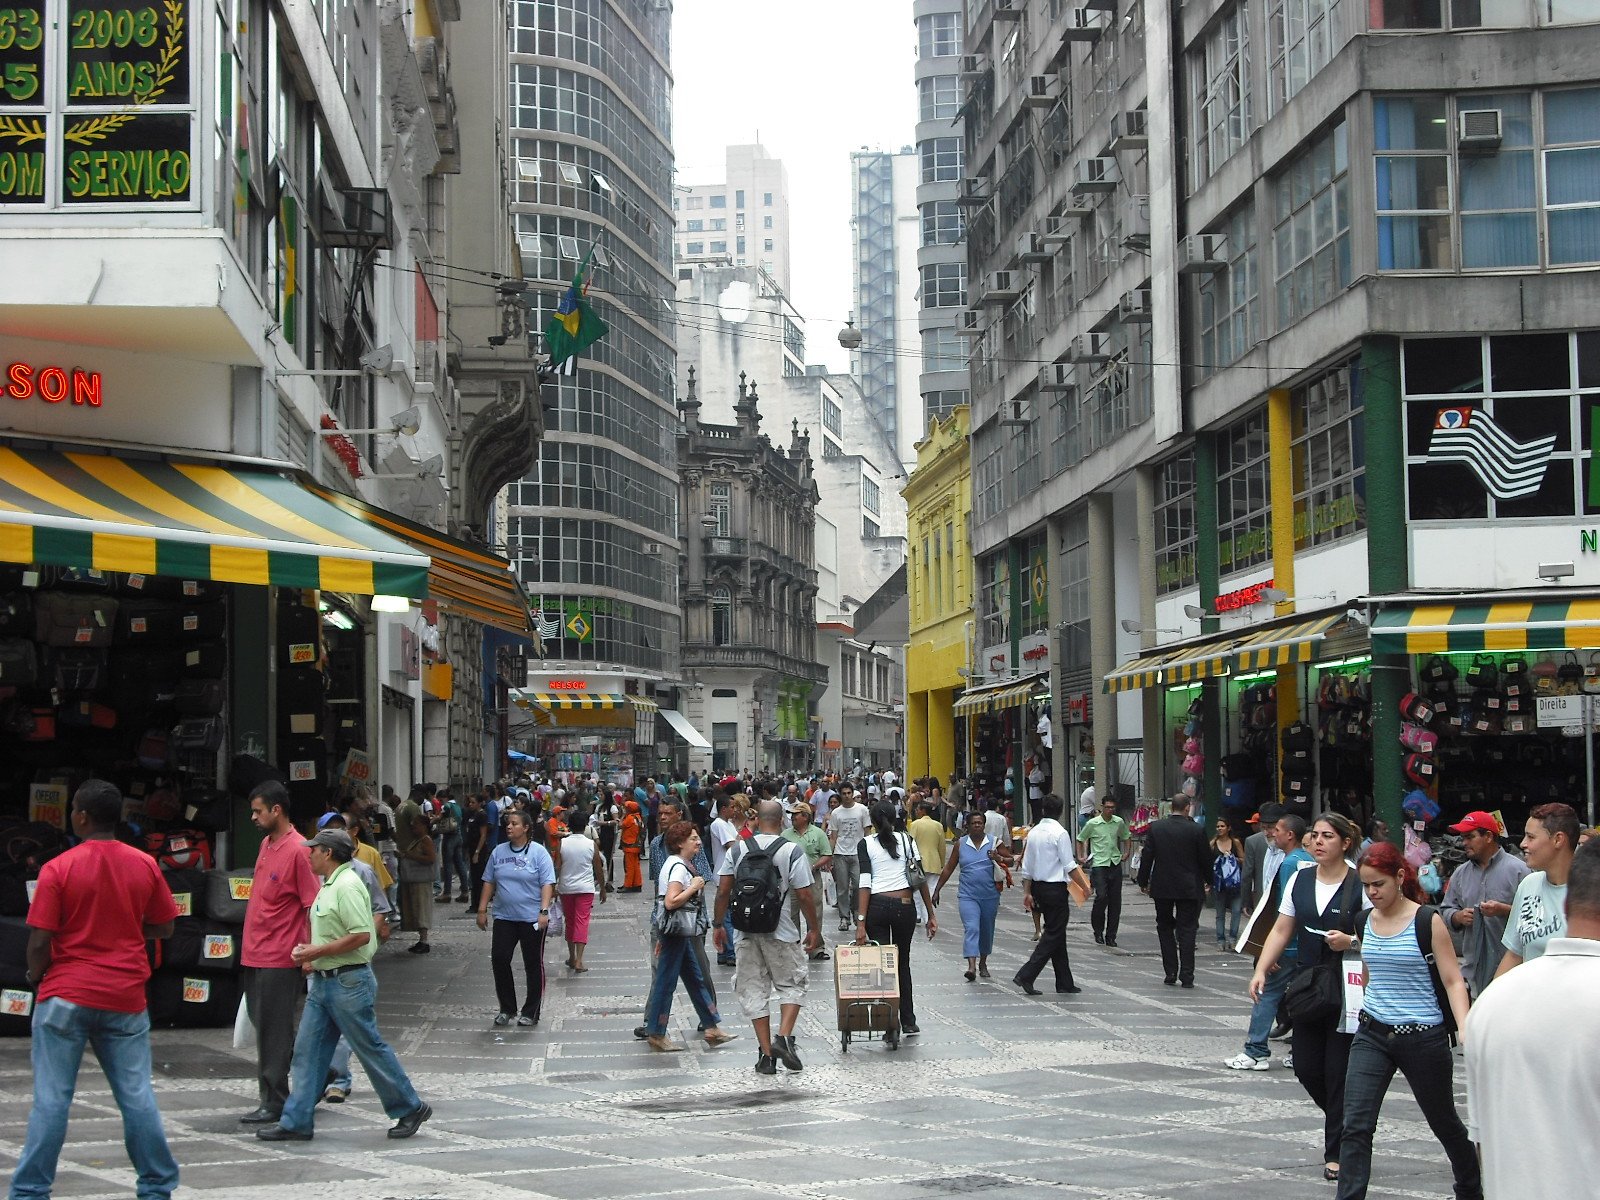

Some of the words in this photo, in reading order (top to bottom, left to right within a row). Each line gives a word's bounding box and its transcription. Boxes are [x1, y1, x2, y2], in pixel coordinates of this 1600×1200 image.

[72, 7, 158, 48] 2008
[0, 63, 38, 100] 5
[69, 61, 155, 96] ANOS
[66, 149, 190, 199] SERVIÇO
[0, 362, 103, 408] SON
[1580, 529, 1597, 552] N
[548, 679, 587, 690] NELSON
[1540, 697, 1567, 711] Direita
